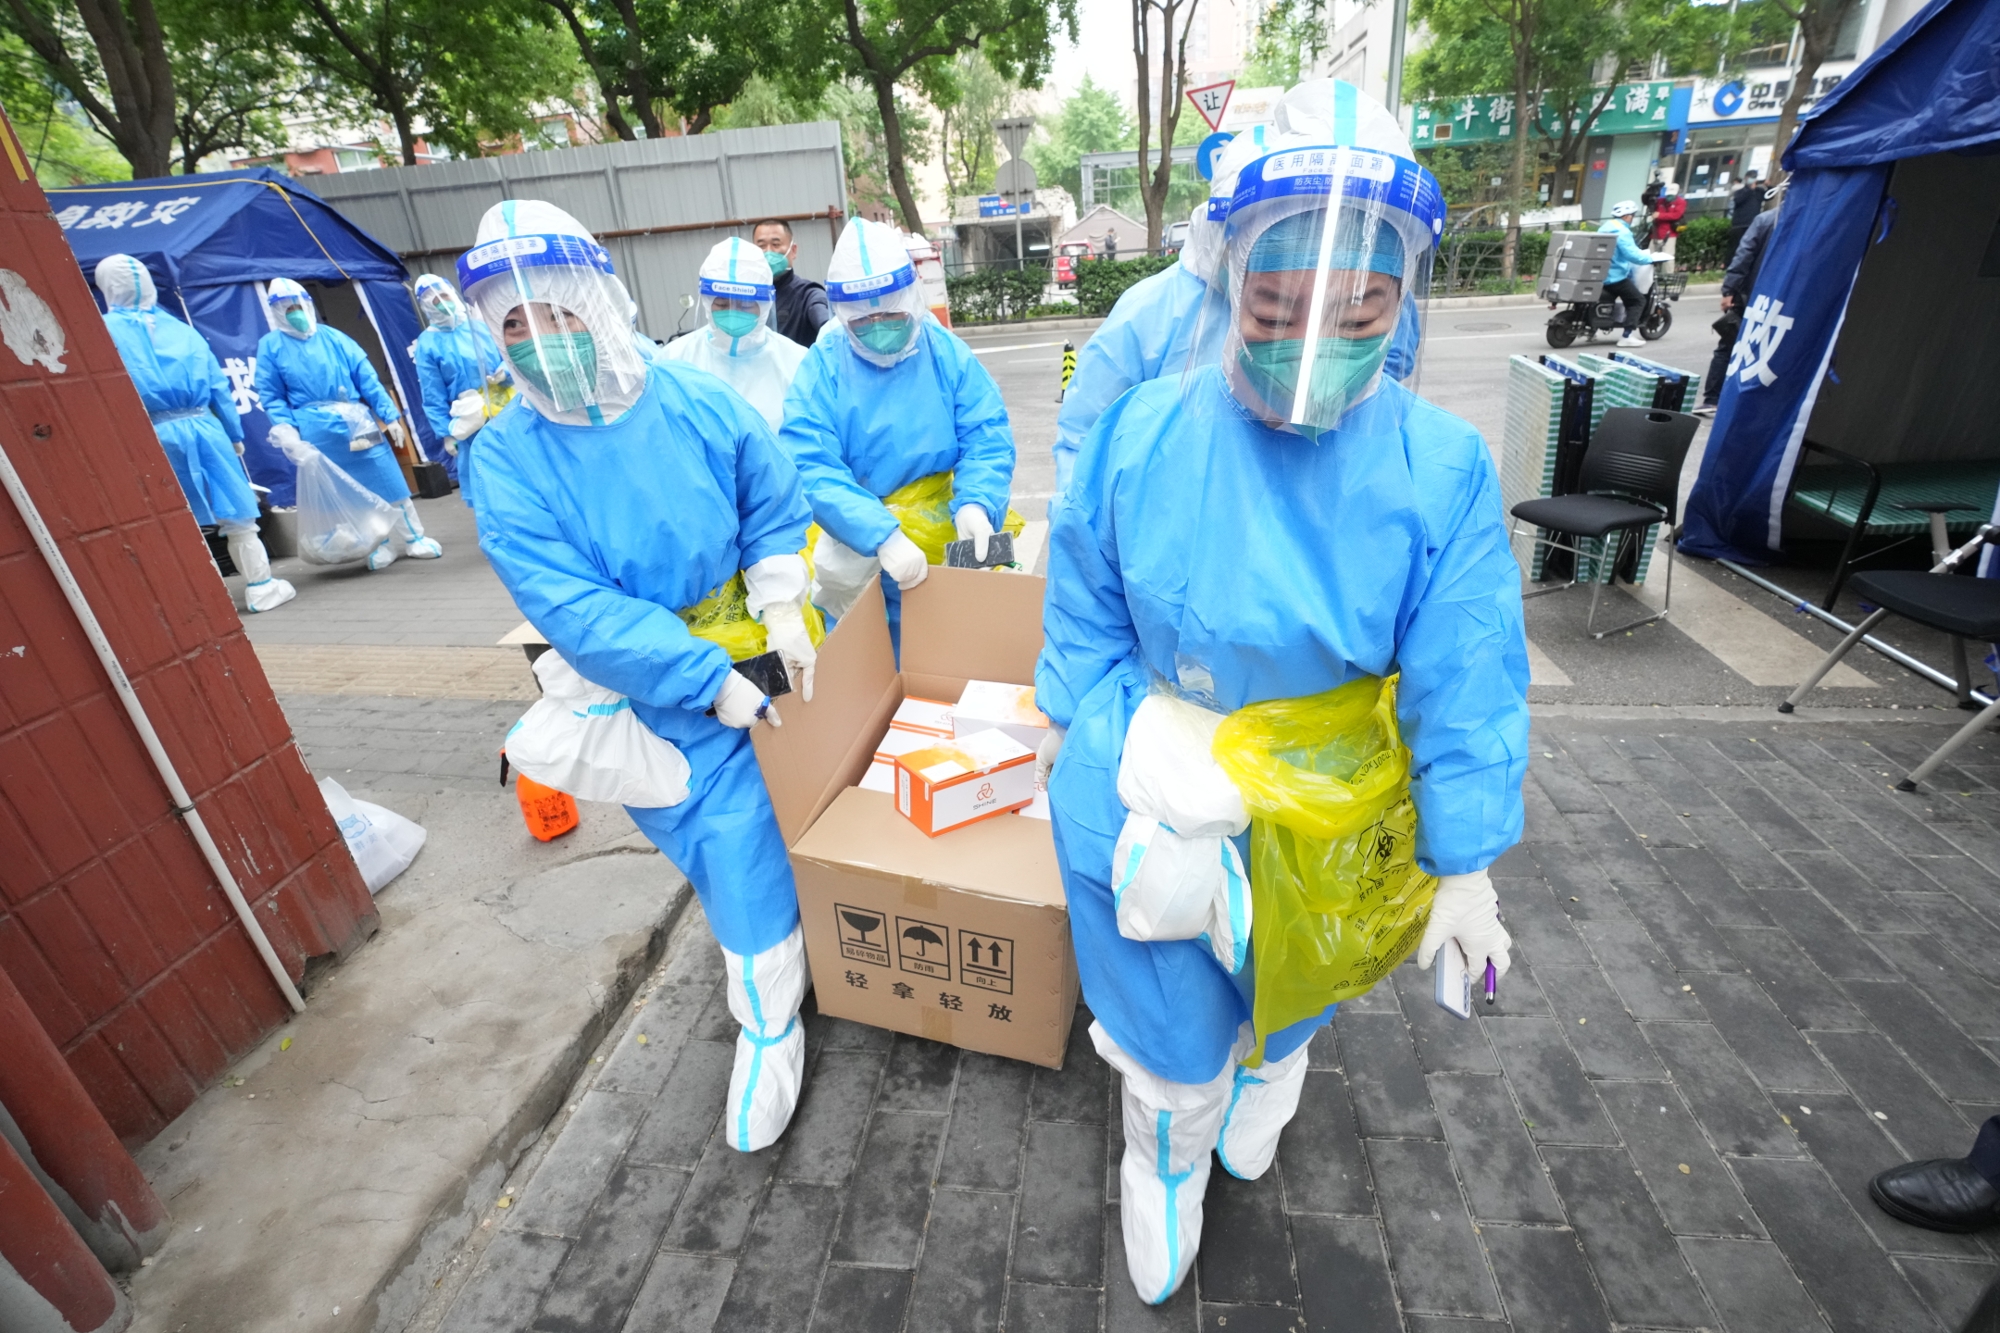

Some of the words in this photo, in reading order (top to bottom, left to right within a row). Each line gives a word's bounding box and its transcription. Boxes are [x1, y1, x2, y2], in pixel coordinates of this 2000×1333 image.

[1203, 91, 1221, 111] 让
[714, 284, 731, 292] Face
[732, 286, 754, 294] Shield
[1726, 294, 1795, 387] 救
[973, 798, 997, 810] SHINE
[846, 947, 886, 962] 易碎物品
[913, 962, 935, 973] 防雨
[976, 976, 997, 988] 向上
[845, 970, 1012, 1022] 轻拿轻放
